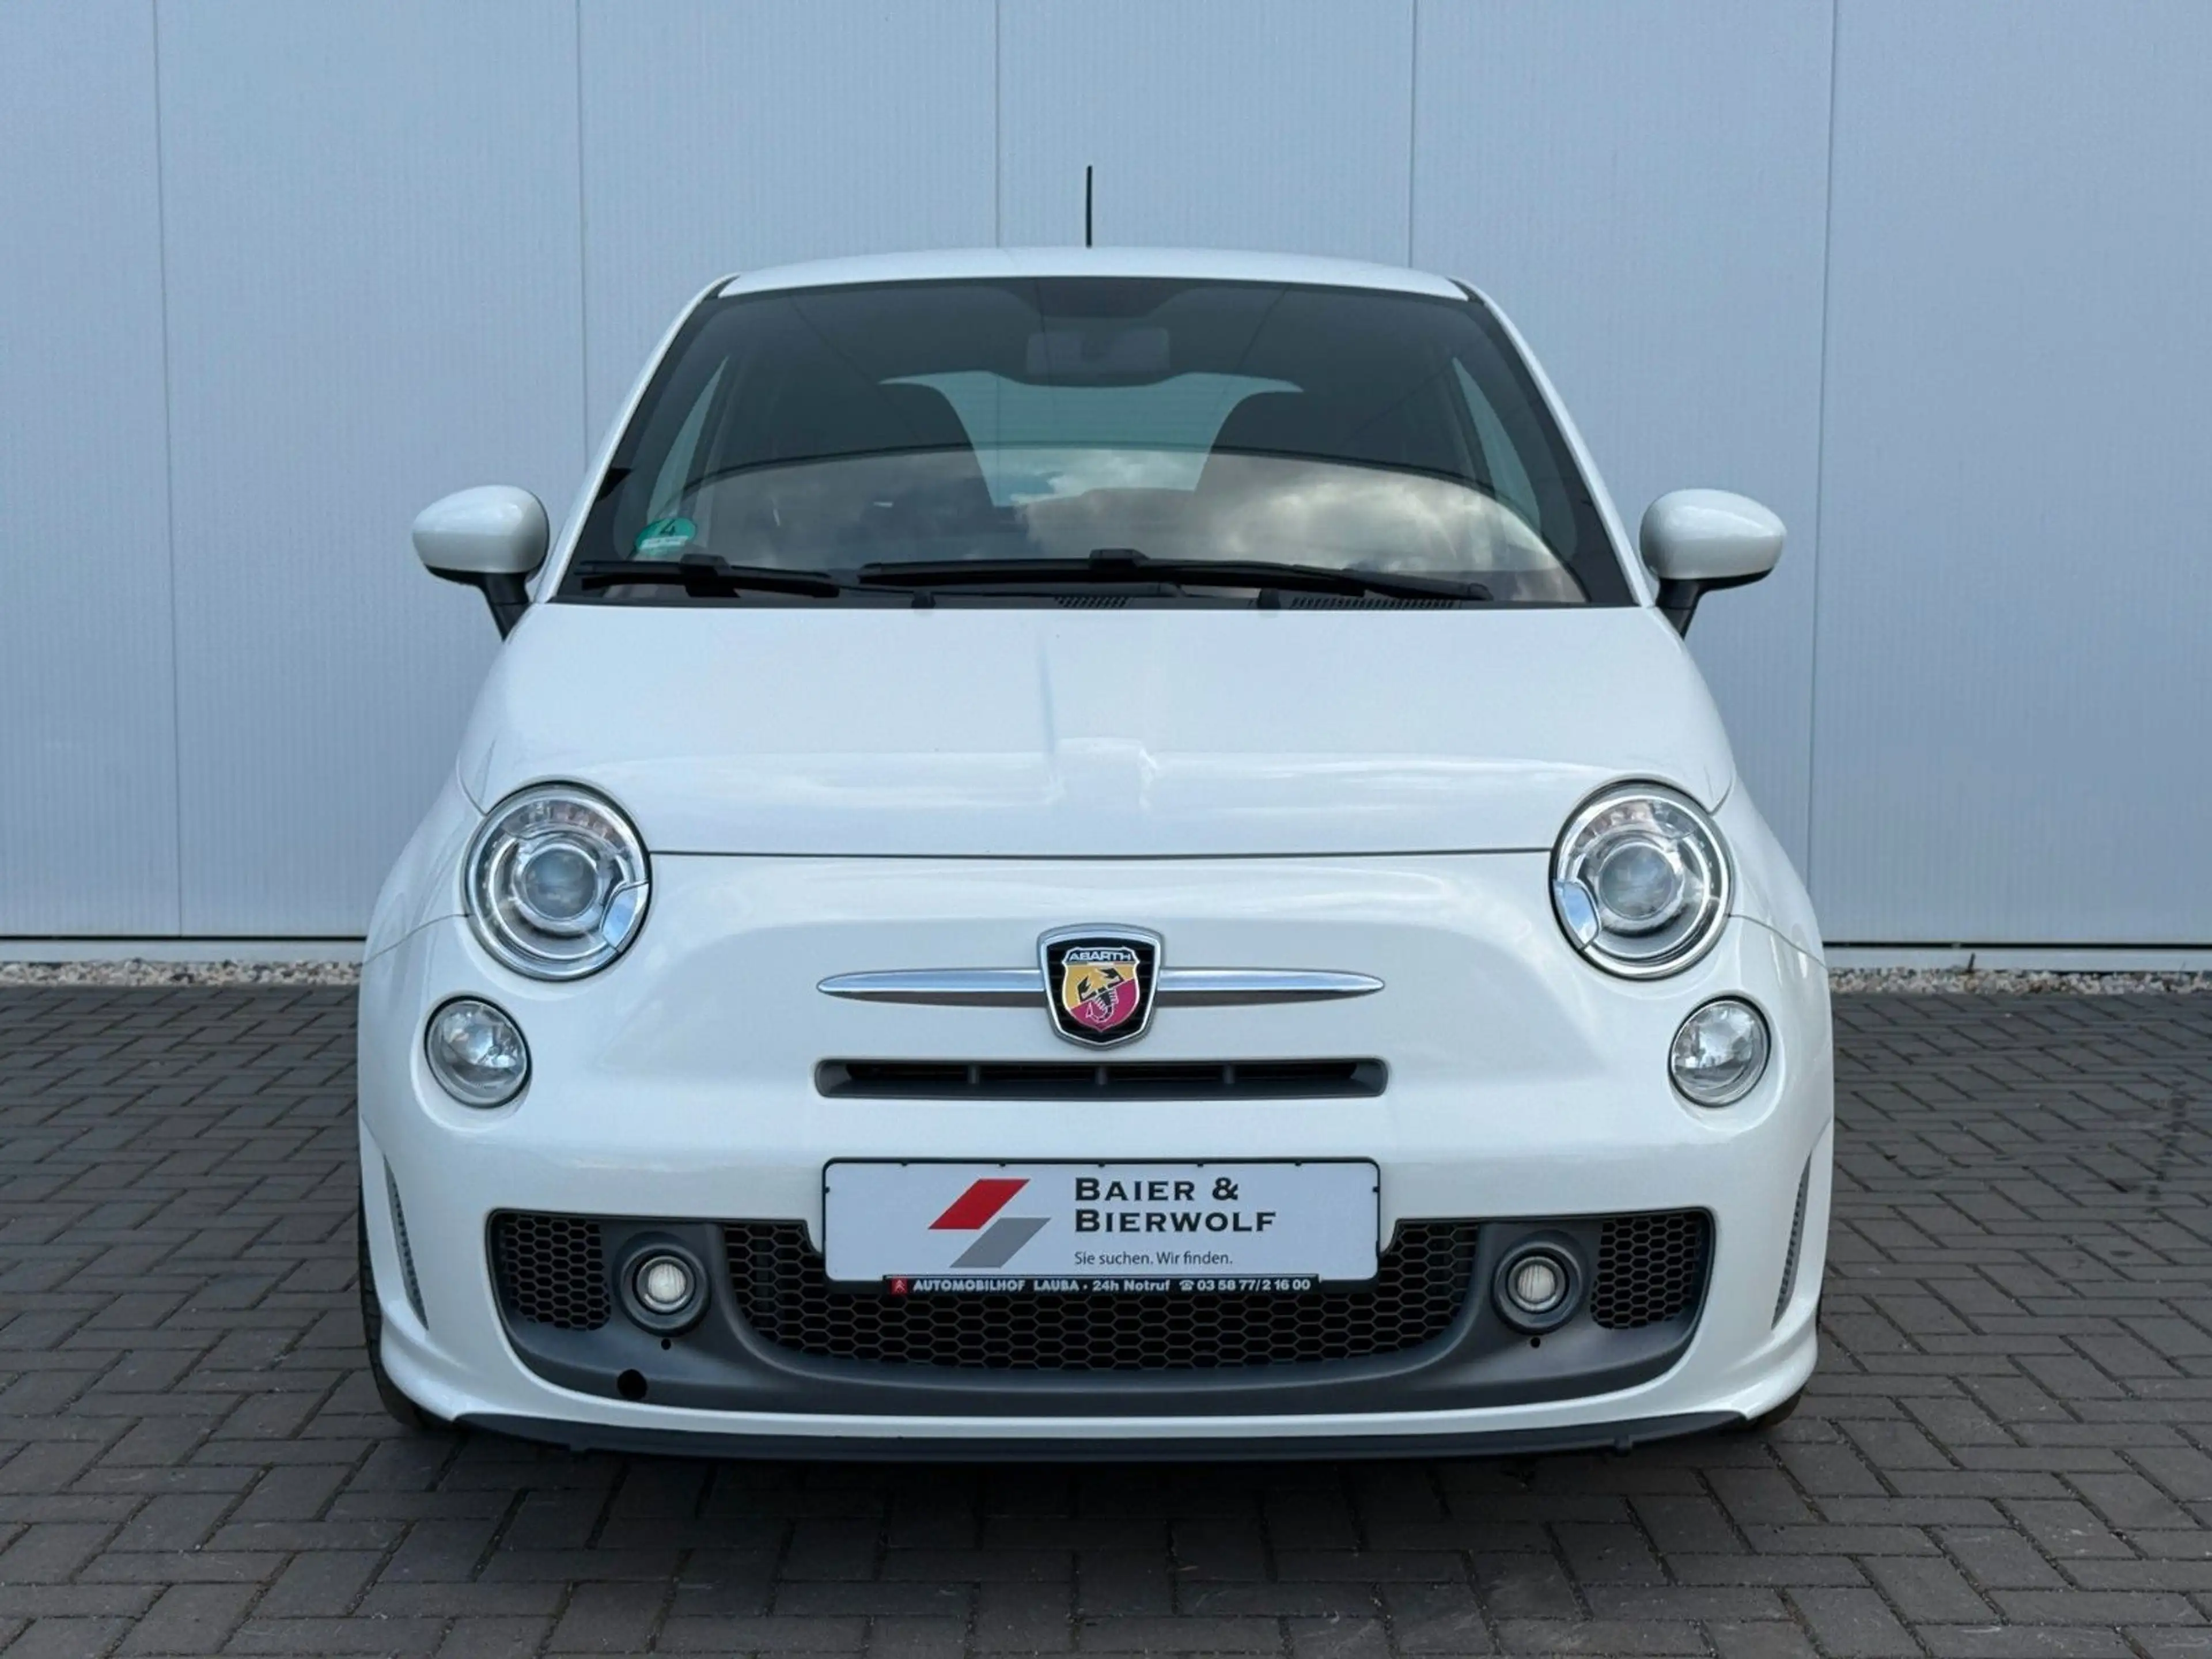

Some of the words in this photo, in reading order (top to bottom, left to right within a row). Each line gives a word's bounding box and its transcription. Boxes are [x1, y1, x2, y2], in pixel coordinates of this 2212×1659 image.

[1069, 951, 1131, 961] ABARTH
[1075, 1177, 1195, 1201] BAIER
[1212, 1176, 1238, 1201] &
[1075, 1209, 1277, 1233] BIERWOLF
[1074, 1251, 1095, 1265] Sie
[1099, 1251, 1153, 1265] suchen.
[1156, 1251, 1180, 1265] Wir
[1183, 1251, 1233, 1265] finden.
[912, 1278, 1026, 1292] AUTOMOBILHOF
[1033, 1278, 1080, 1291] LAUBA
[1092, 1278, 1119, 1291] 24h
[1123, 1278, 1171, 1291] Notruf
